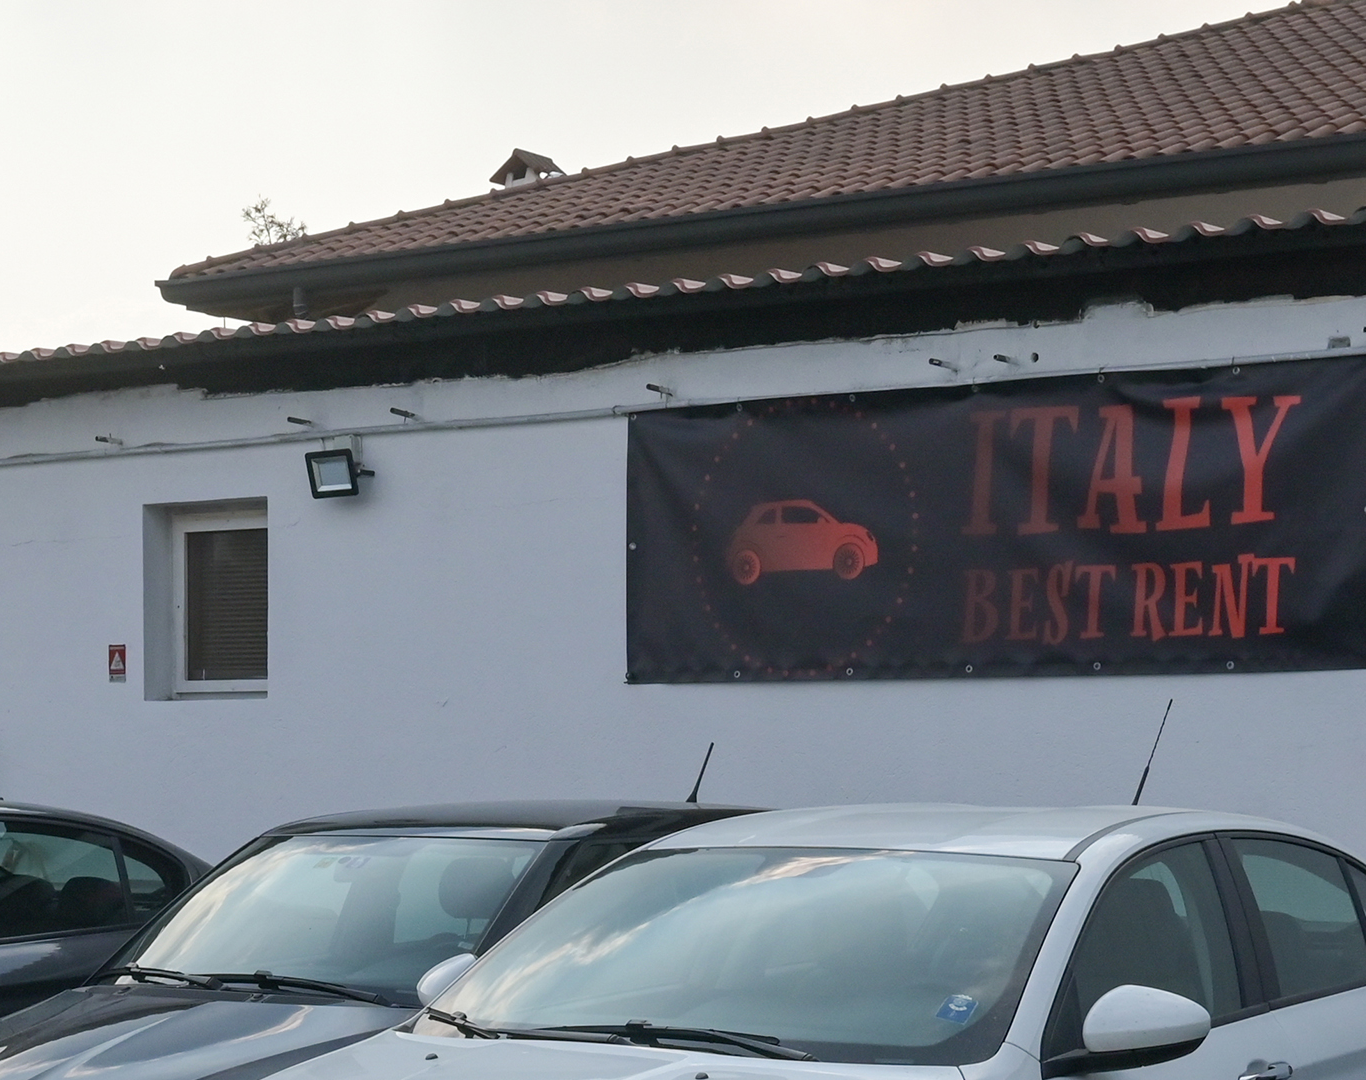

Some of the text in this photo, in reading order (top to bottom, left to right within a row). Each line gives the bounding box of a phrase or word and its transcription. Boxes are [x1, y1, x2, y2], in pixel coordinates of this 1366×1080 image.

[960, 395, 1302, 535] ITALY
[961, 553, 1296, 645] BEST RENT
